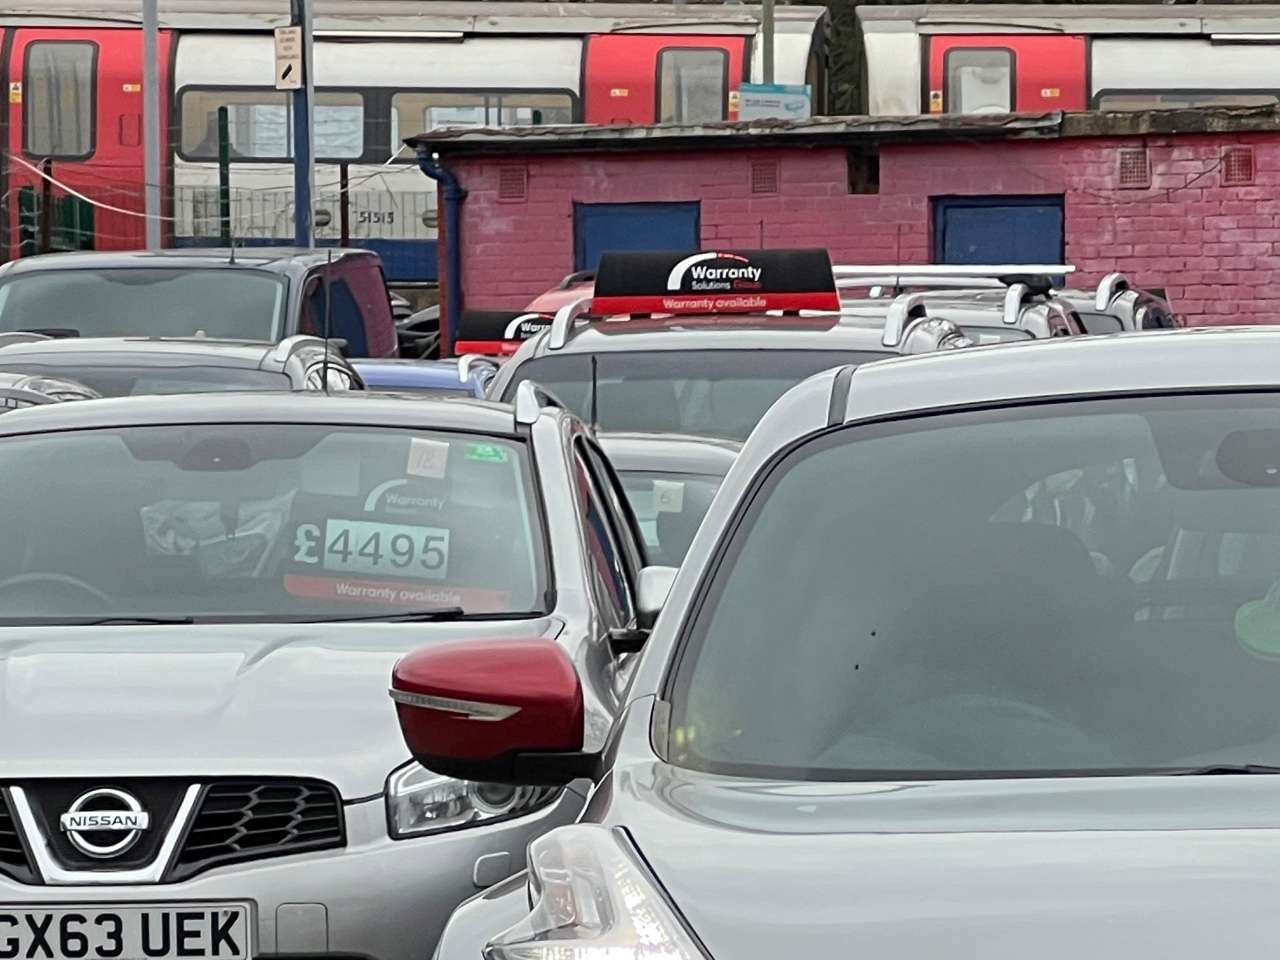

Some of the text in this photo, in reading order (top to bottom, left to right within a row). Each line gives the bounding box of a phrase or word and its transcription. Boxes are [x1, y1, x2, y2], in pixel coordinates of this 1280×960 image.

[690, 265, 762, 281] Warranty
[690, 280, 731, 290] Solutions
[662, 295, 767, 310] Warranty available
[386, 492, 446, 510] Warranty
[294, 523, 446, 571] £4495
[336, 583, 461, 603] Warranty available
[69, 815, 138, 827] NISSAN
[0, 910, 240, 959] GX63 UEK
